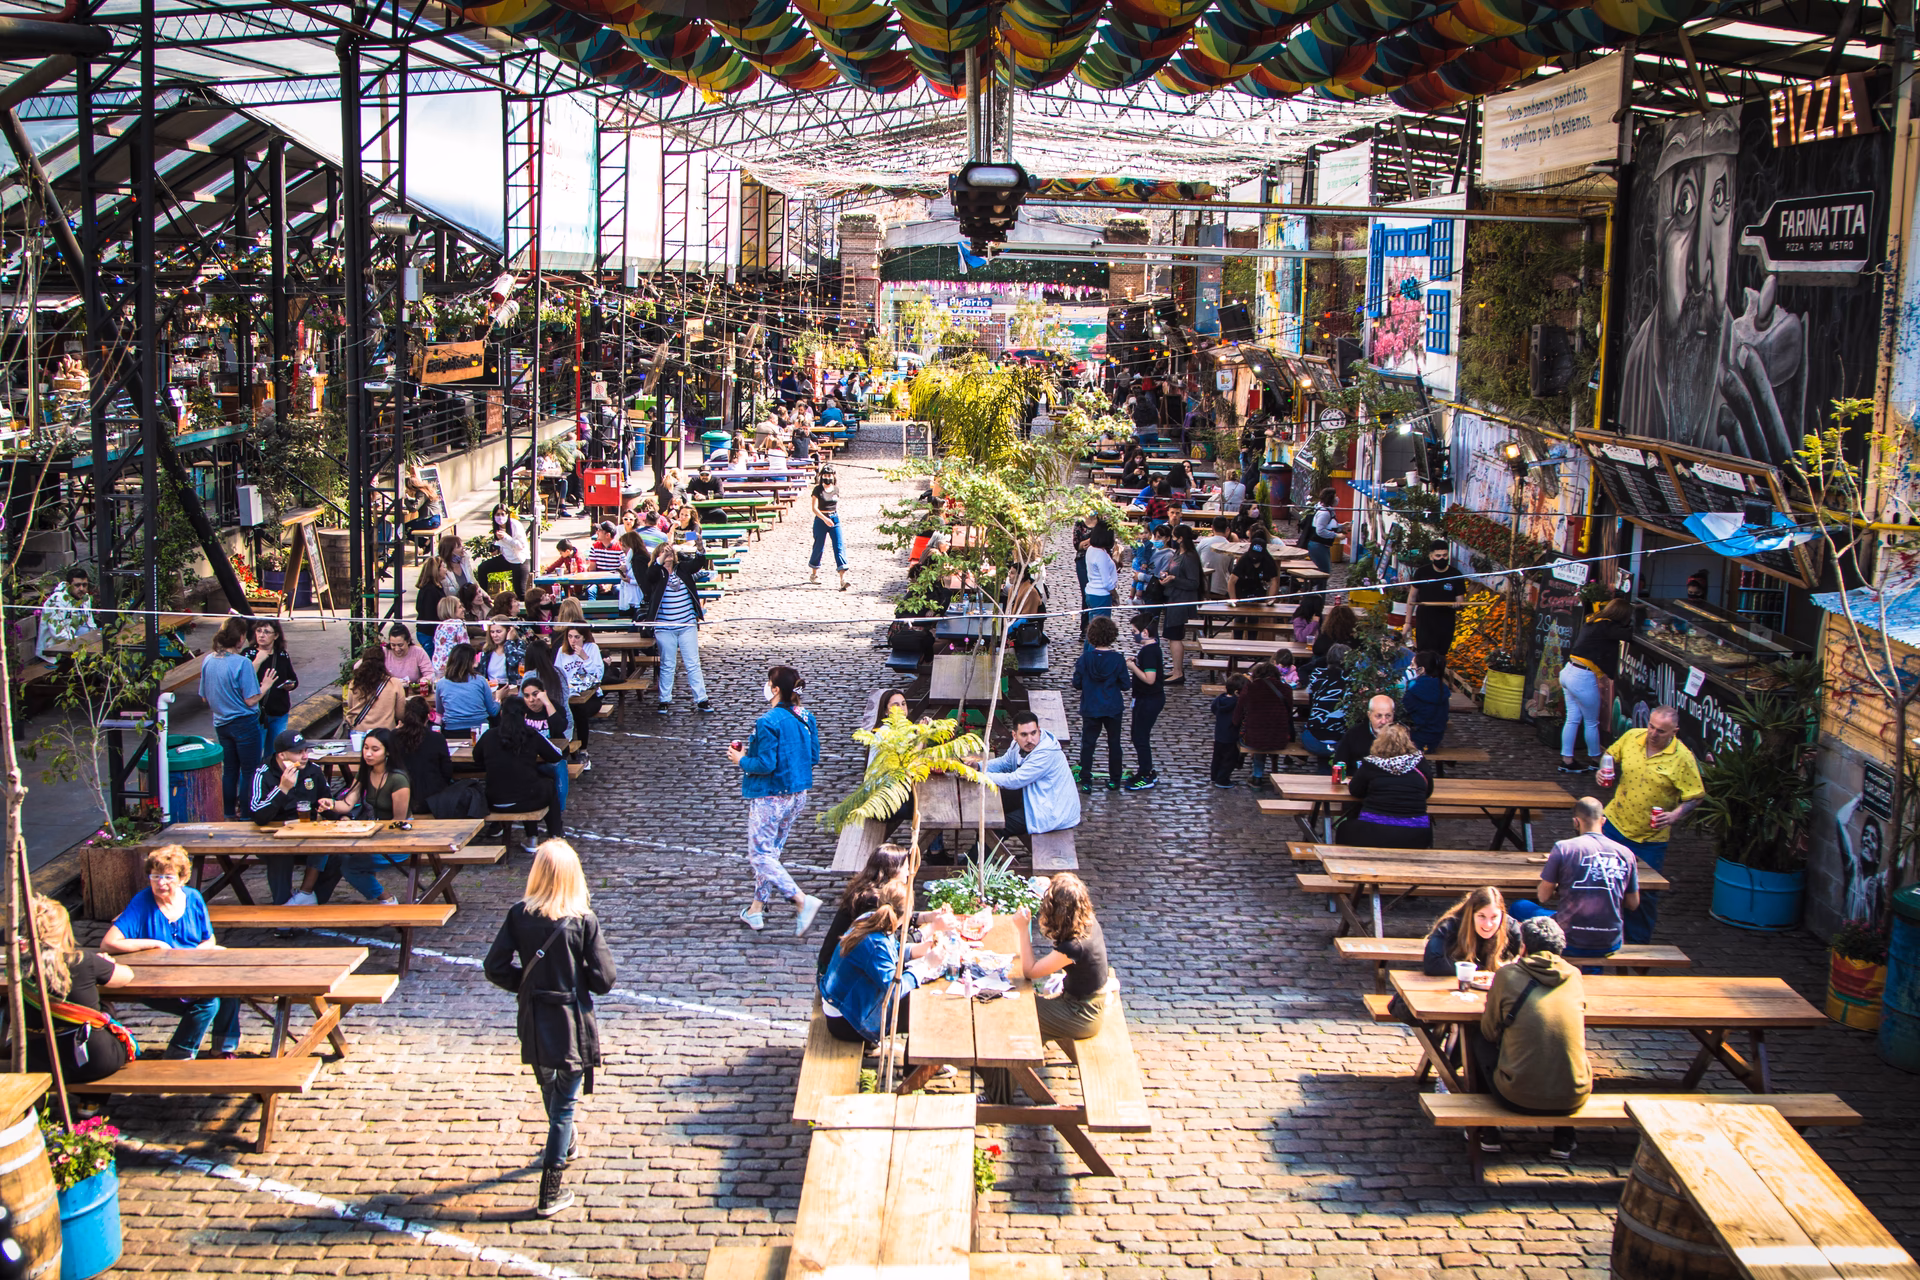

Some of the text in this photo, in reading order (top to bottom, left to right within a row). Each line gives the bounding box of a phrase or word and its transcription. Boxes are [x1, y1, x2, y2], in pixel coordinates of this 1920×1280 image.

[1507, 105, 1522, 121] Que
[1523, 97, 1553, 117] andemos
[1770, 74, 1858, 148] PIZZA
[1501, 137, 1509, 149] no
[1538, 126, 1551, 146] que
[1551, 116, 1560, 136] lo
[1779, 204, 1866, 238] FARINATTA
[1786, 240, 1854, 251] PIZZA POR METRO
[949, 297, 990, 307] Piperno
